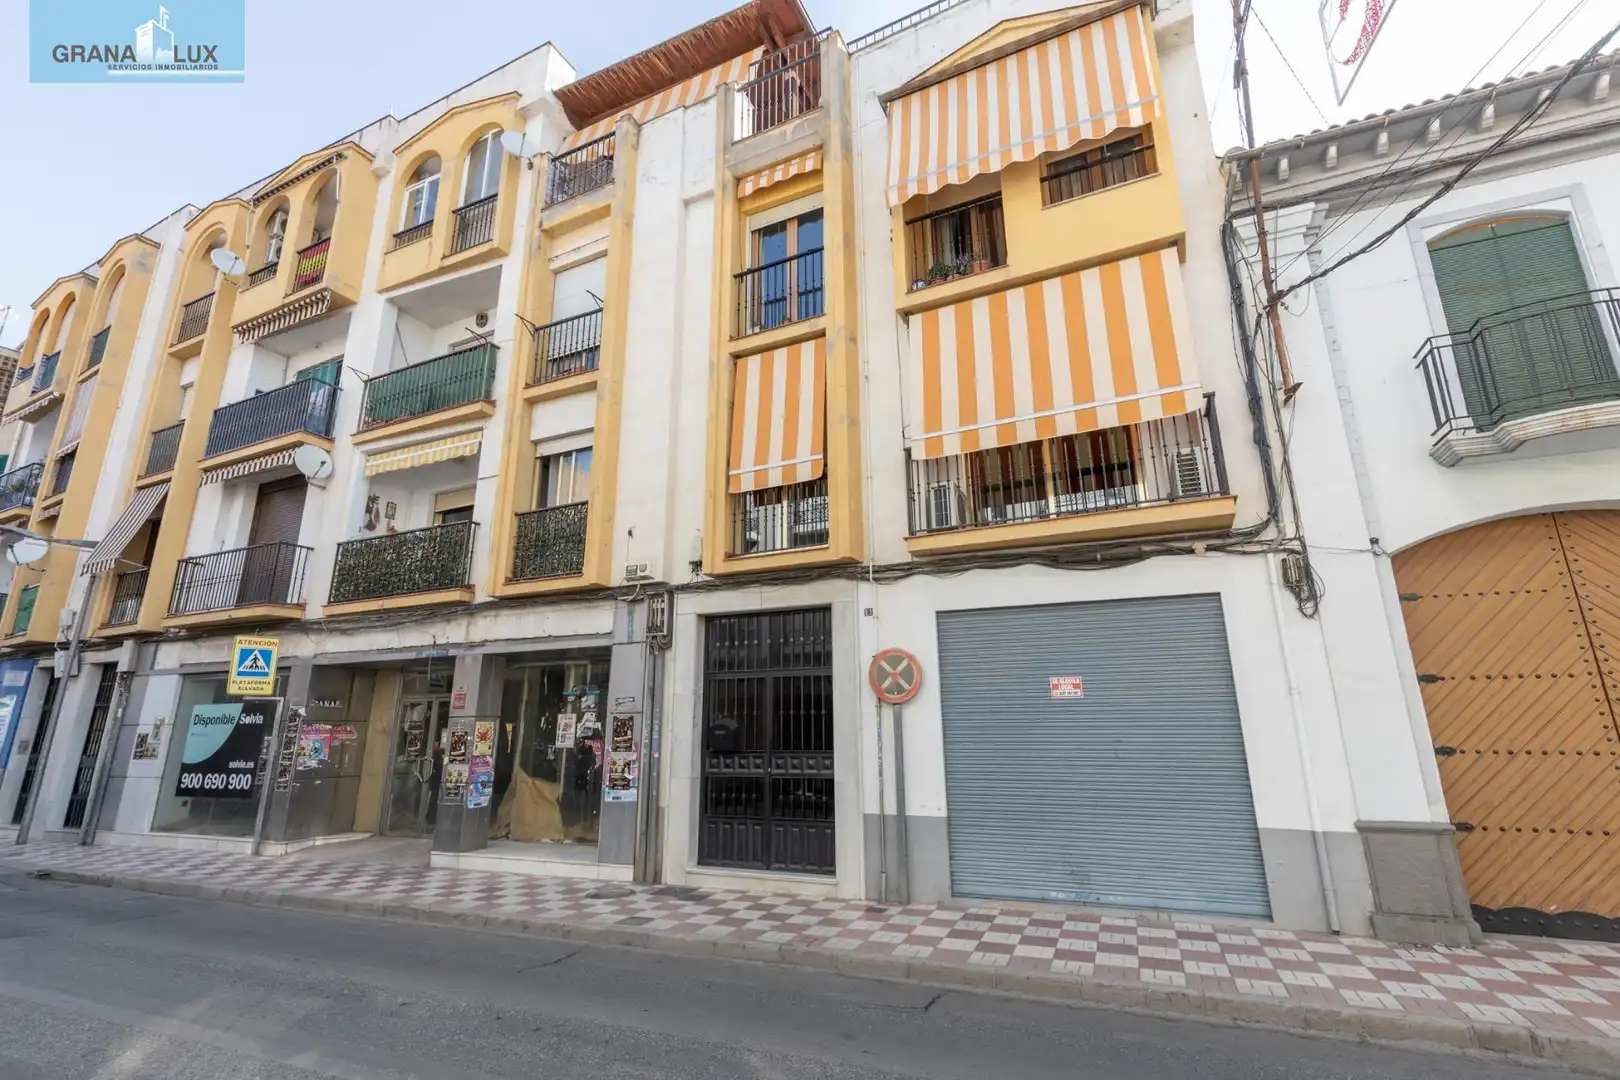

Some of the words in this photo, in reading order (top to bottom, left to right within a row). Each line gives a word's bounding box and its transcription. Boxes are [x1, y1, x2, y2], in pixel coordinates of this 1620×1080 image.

[237, 639, 278, 647] ATENCION
[193, 713, 236, 728] Disponible
[239, 713, 264, 725] Solvia
[228, 760, 255, 769] solvia.es
[180, 773, 202, 788] 900
[203, 773, 226, 790] 690
[228, 773, 251, 790] 900
